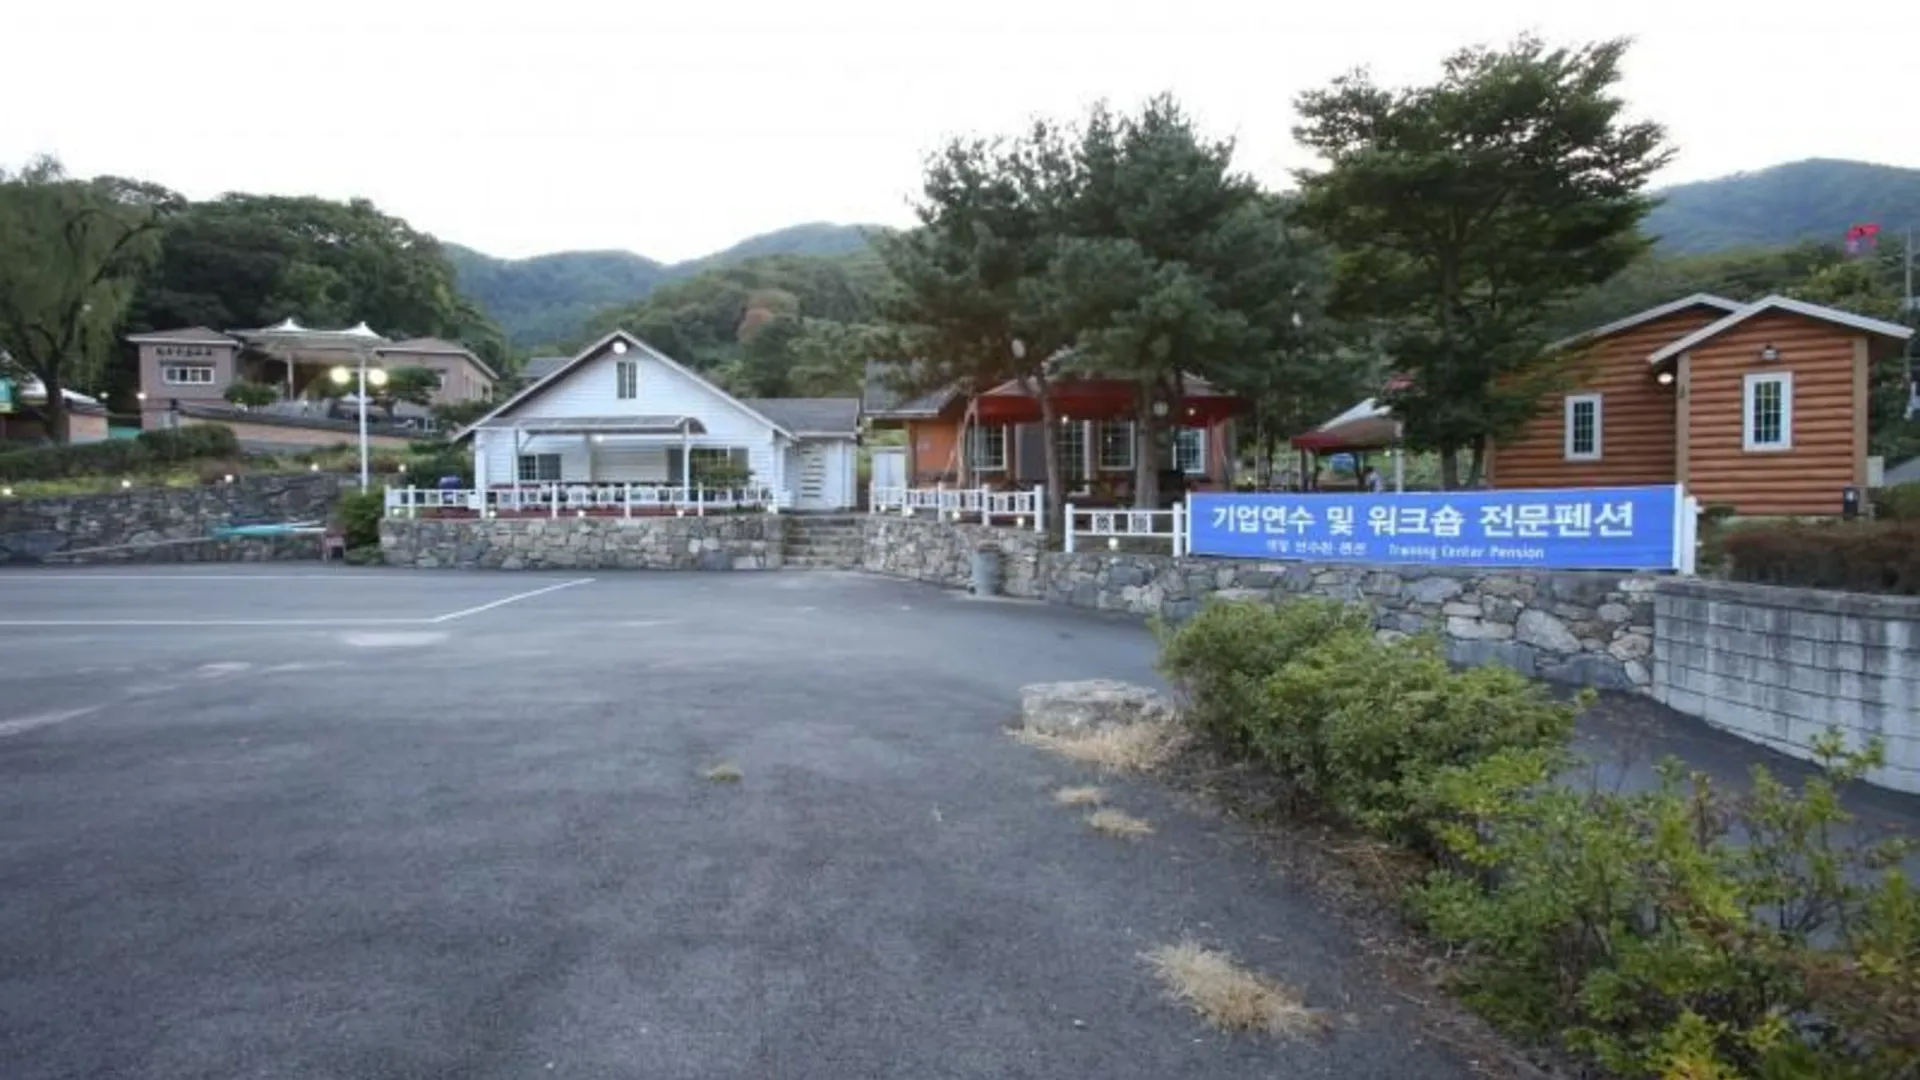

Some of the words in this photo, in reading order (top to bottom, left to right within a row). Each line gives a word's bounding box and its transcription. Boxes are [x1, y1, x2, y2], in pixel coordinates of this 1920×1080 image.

[1212, 504, 1316, 534] 기업연수
[1326, 505, 1355, 536] 및
[1367, 504, 1466, 537] 워크숍
[1479, 502, 1634, 537] 전문펜션
[1441, 544, 1485, 559] Center
[1490, 542, 1545, 560] Pension
